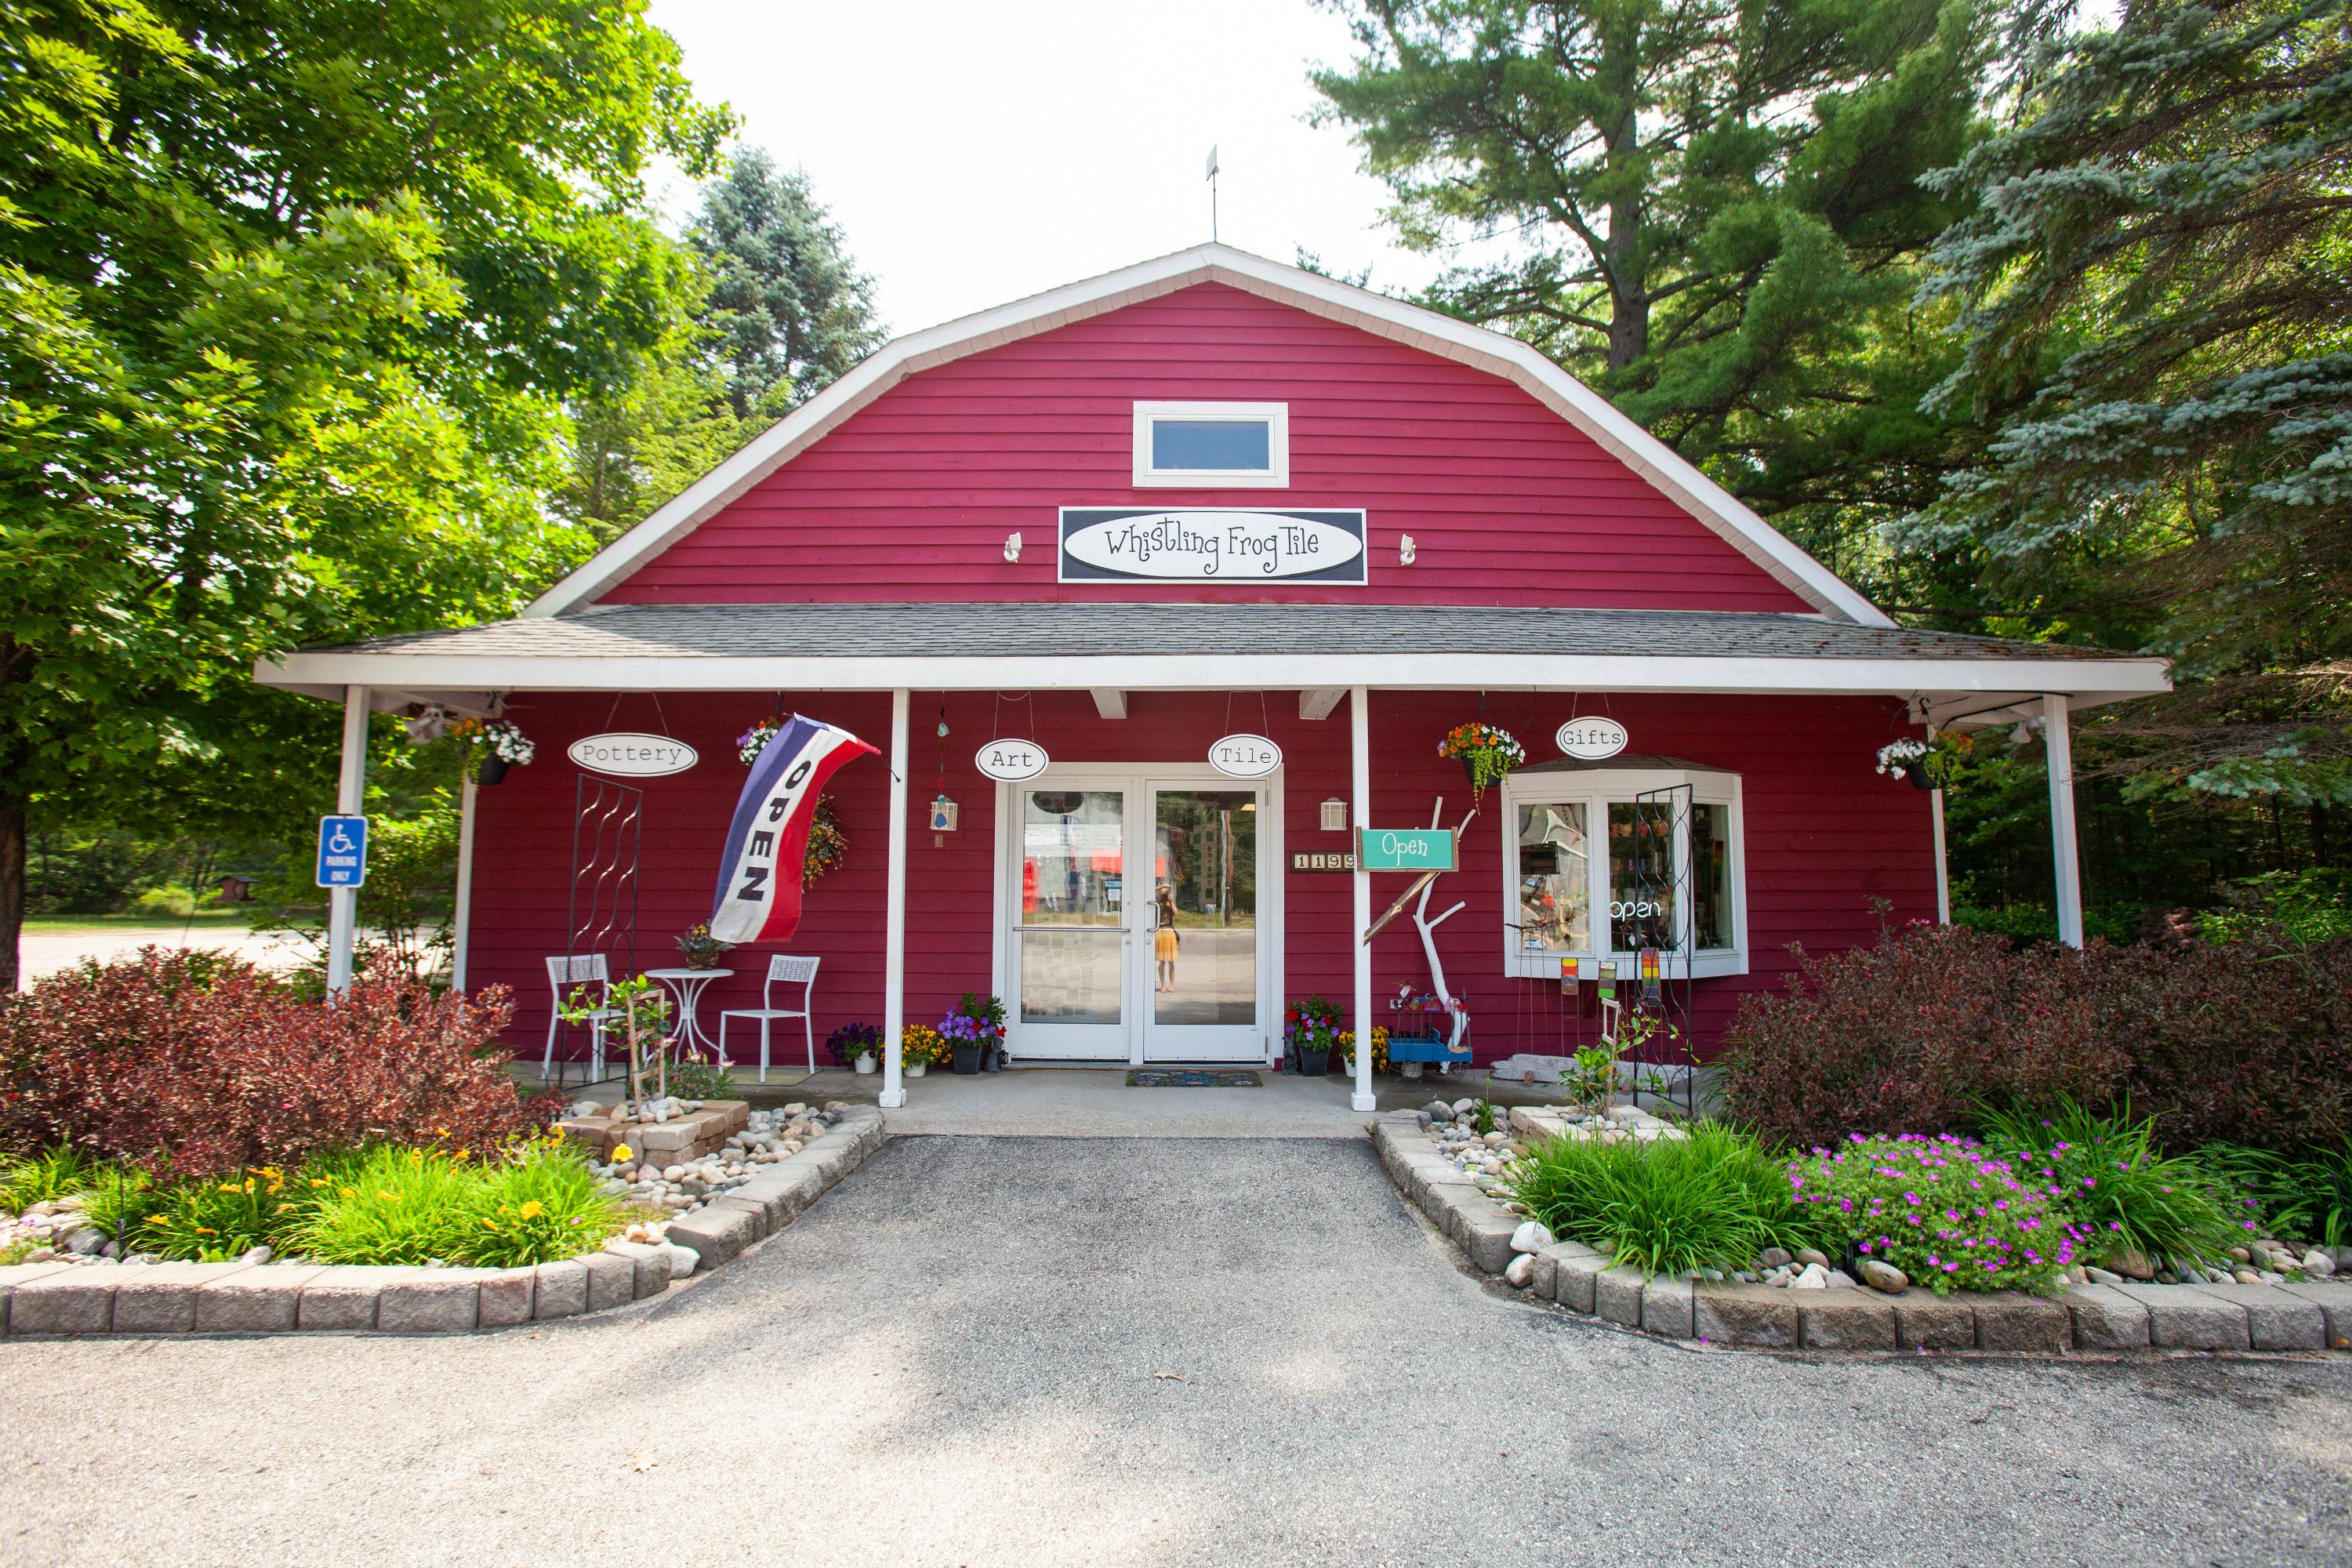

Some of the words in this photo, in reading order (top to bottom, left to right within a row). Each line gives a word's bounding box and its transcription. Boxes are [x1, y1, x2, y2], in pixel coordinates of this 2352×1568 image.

[1105, 517, 1219, 575] Whistling
[1228, 526, 1278, 573] Frog
[1279, 526, 1319, 555] Tile
[1563, 729, 1621, 745] Gifts
[583, 745, 682, 765] Pottery
[990, 750, 1033, 768] Art
[1220, 747, 1272, 764] Tile
[736, 760, 812, 902] OPEN
[1381, 833, 1428, 866] Open
[325, 856, 358, 866] PARKING
[1298, 855, 1355, 867] 1199
[331, 871, 350, 881] ONLY
[1609, 901, 1661, 922] open
